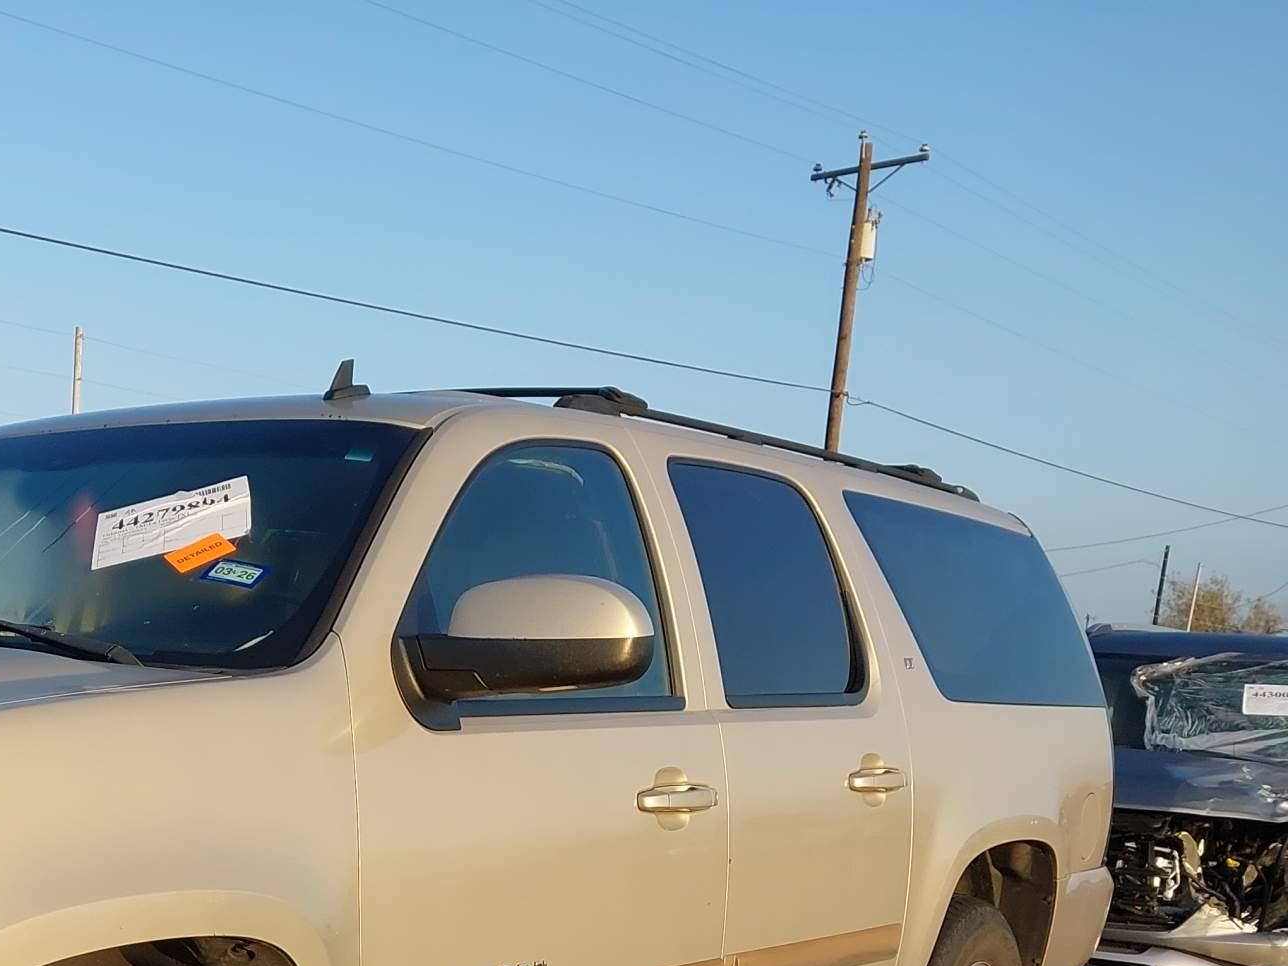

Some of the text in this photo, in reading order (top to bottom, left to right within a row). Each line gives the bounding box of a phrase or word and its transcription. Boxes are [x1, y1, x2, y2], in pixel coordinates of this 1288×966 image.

[176, 541, 222, 564] DETAILED
[214, 566, 233, 576] 03
[236, 570, 257, 580] 26
